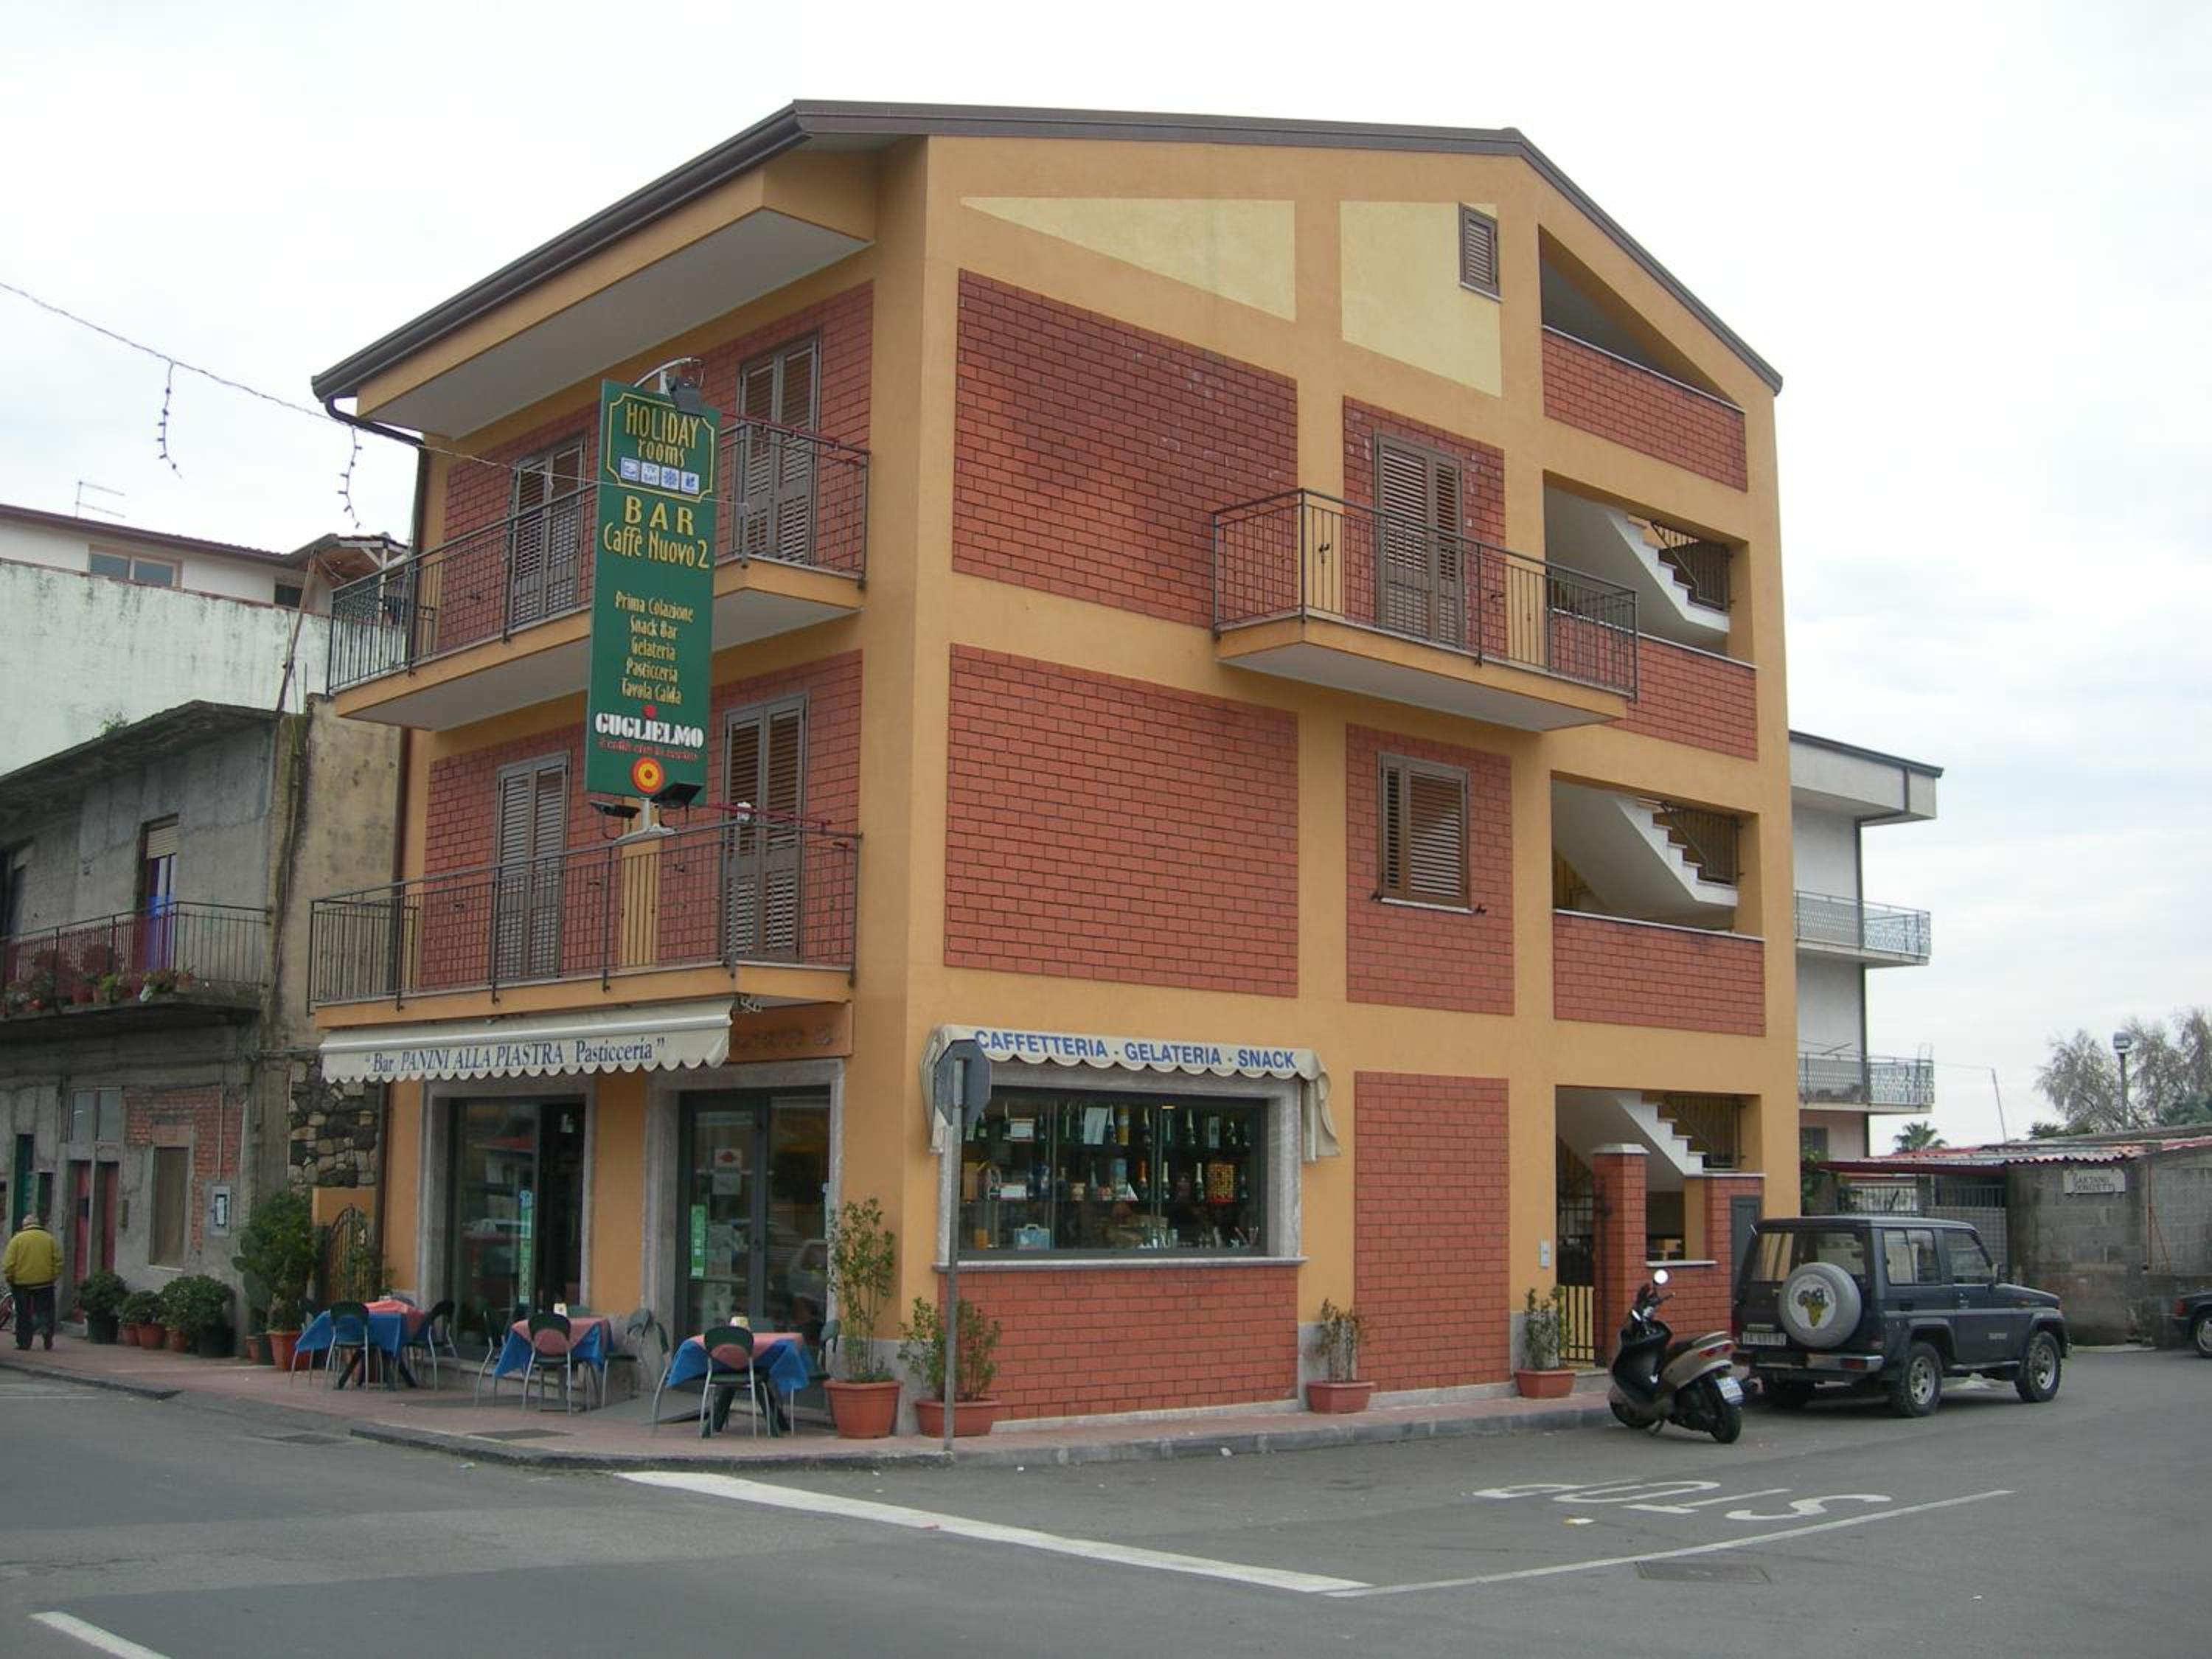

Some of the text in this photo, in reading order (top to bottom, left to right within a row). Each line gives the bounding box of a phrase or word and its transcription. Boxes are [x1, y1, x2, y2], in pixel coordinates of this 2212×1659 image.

[625, 402, 700, 449] HOLIDAY
[638, 438, 685, 468] rooms
[625, 495, 694, 536] BAR
[648, 529, 695, 567] Nuovo
[615, 591, 694, 623] Prima Colazione
[630, 614, 678, 640] Snack Bar
[631, 636, 676, 661] Gelateria
[625, 657, 678, 684] Pasticceria
[622, 677, 682, 705] Tavola Calda
[400, 1048, 450, 1071] PANINI
[453, 1045, 491, 1070] ALLA
[495, 1040, 564, 1068] PIASTRA
[974, 1030, 1109, 1058] CAFFETTERIA
[1124, 1042, 1222, 1065] GELATERIA
[1237, 1048, 1297, 1069] SNACK
